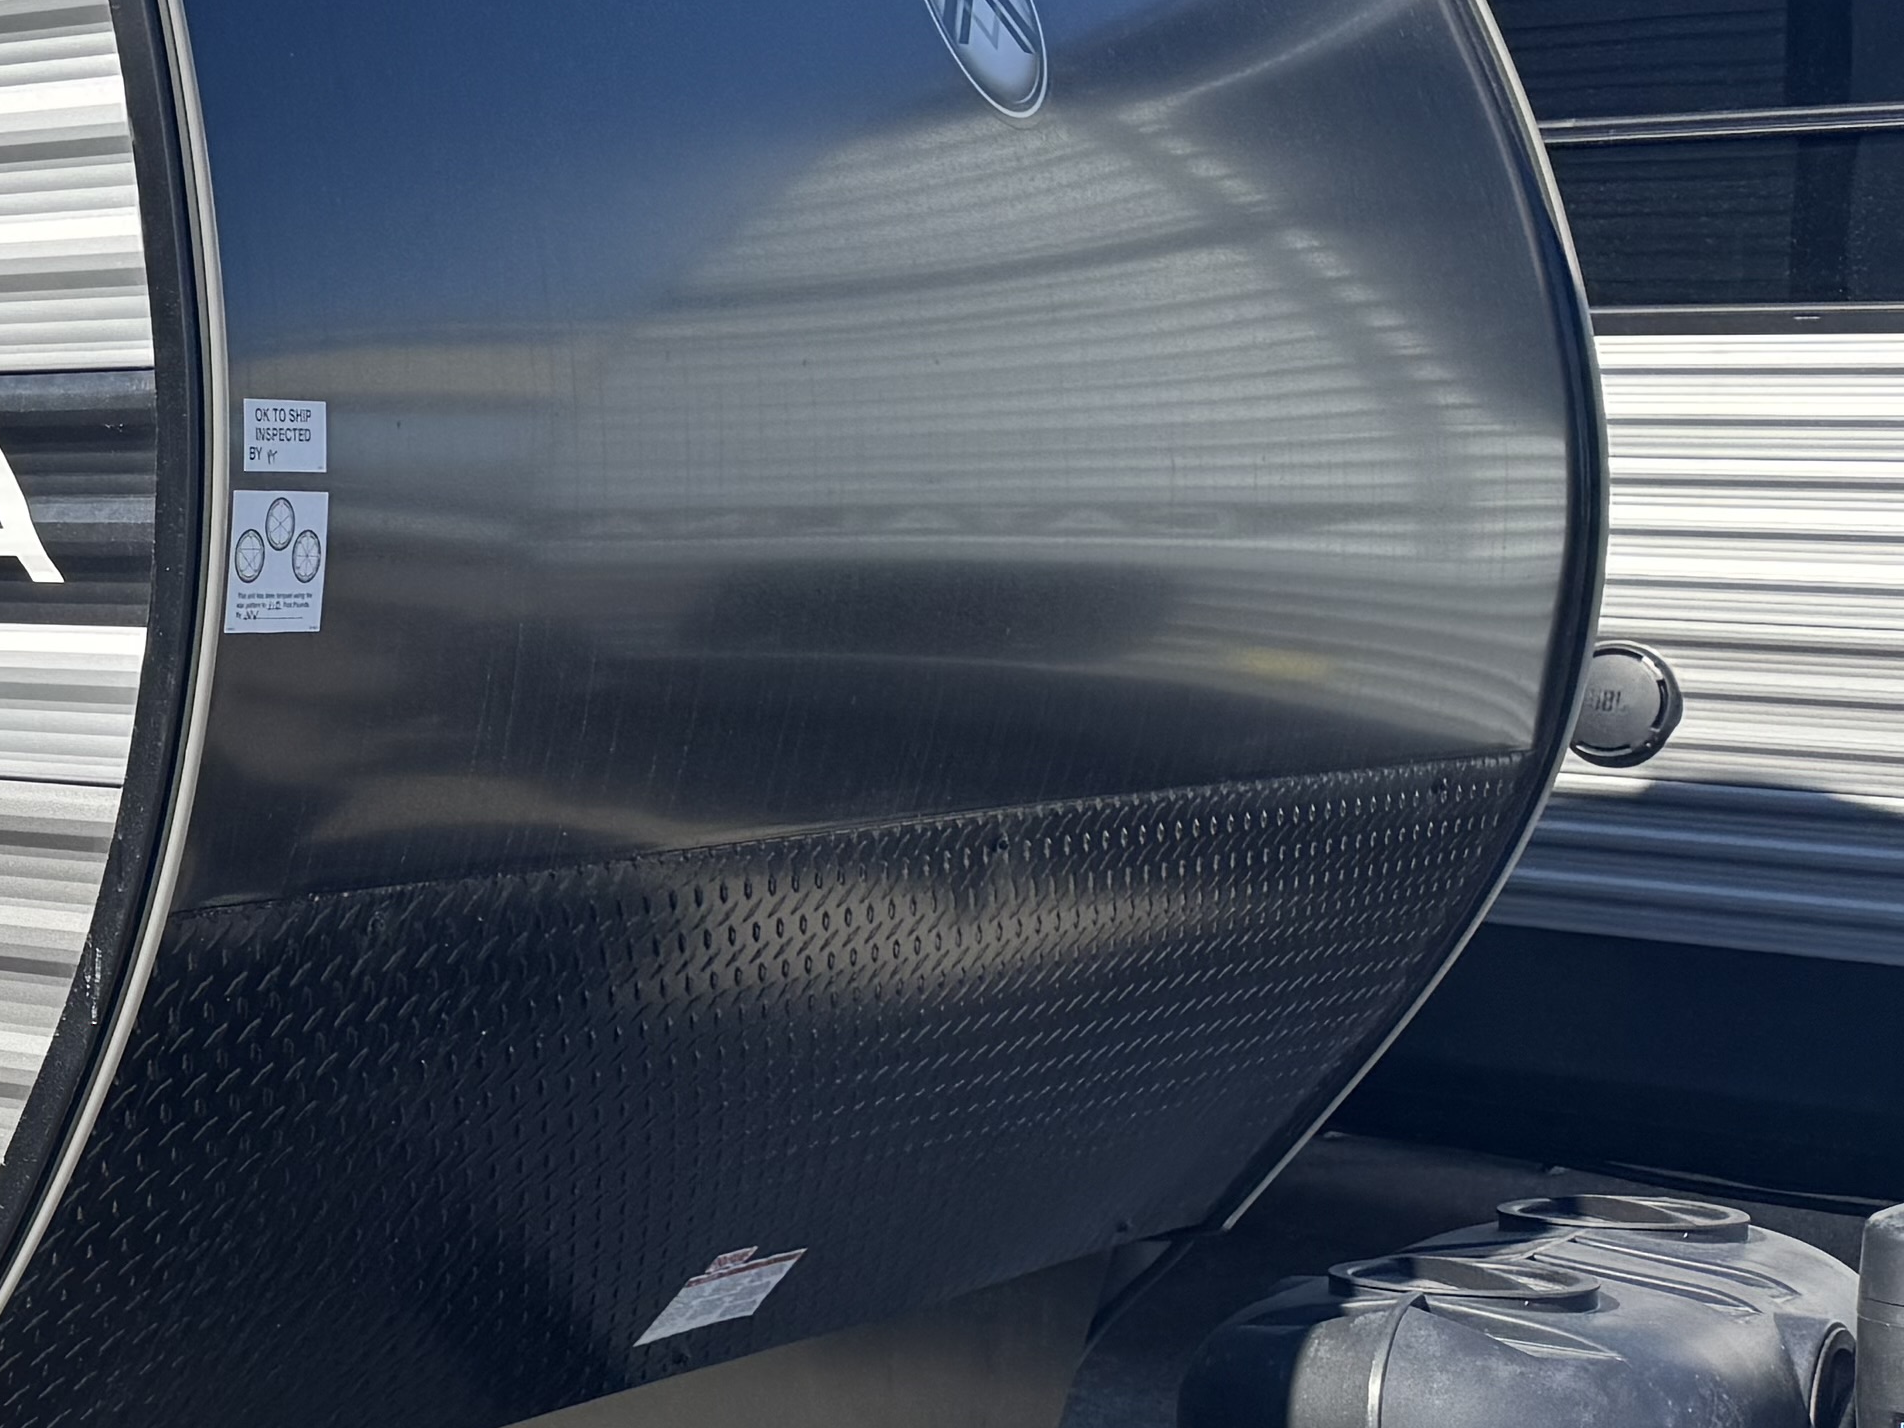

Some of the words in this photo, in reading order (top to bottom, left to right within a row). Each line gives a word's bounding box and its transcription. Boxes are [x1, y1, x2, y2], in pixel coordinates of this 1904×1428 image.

[255, 408, 270, 422] OK
[272, 408, 286, 422] TO
[288, 408, 312, 423] SHIP
[255, 427, 311, 442] INSPECTED
[249, 446, 262, 460] BY
